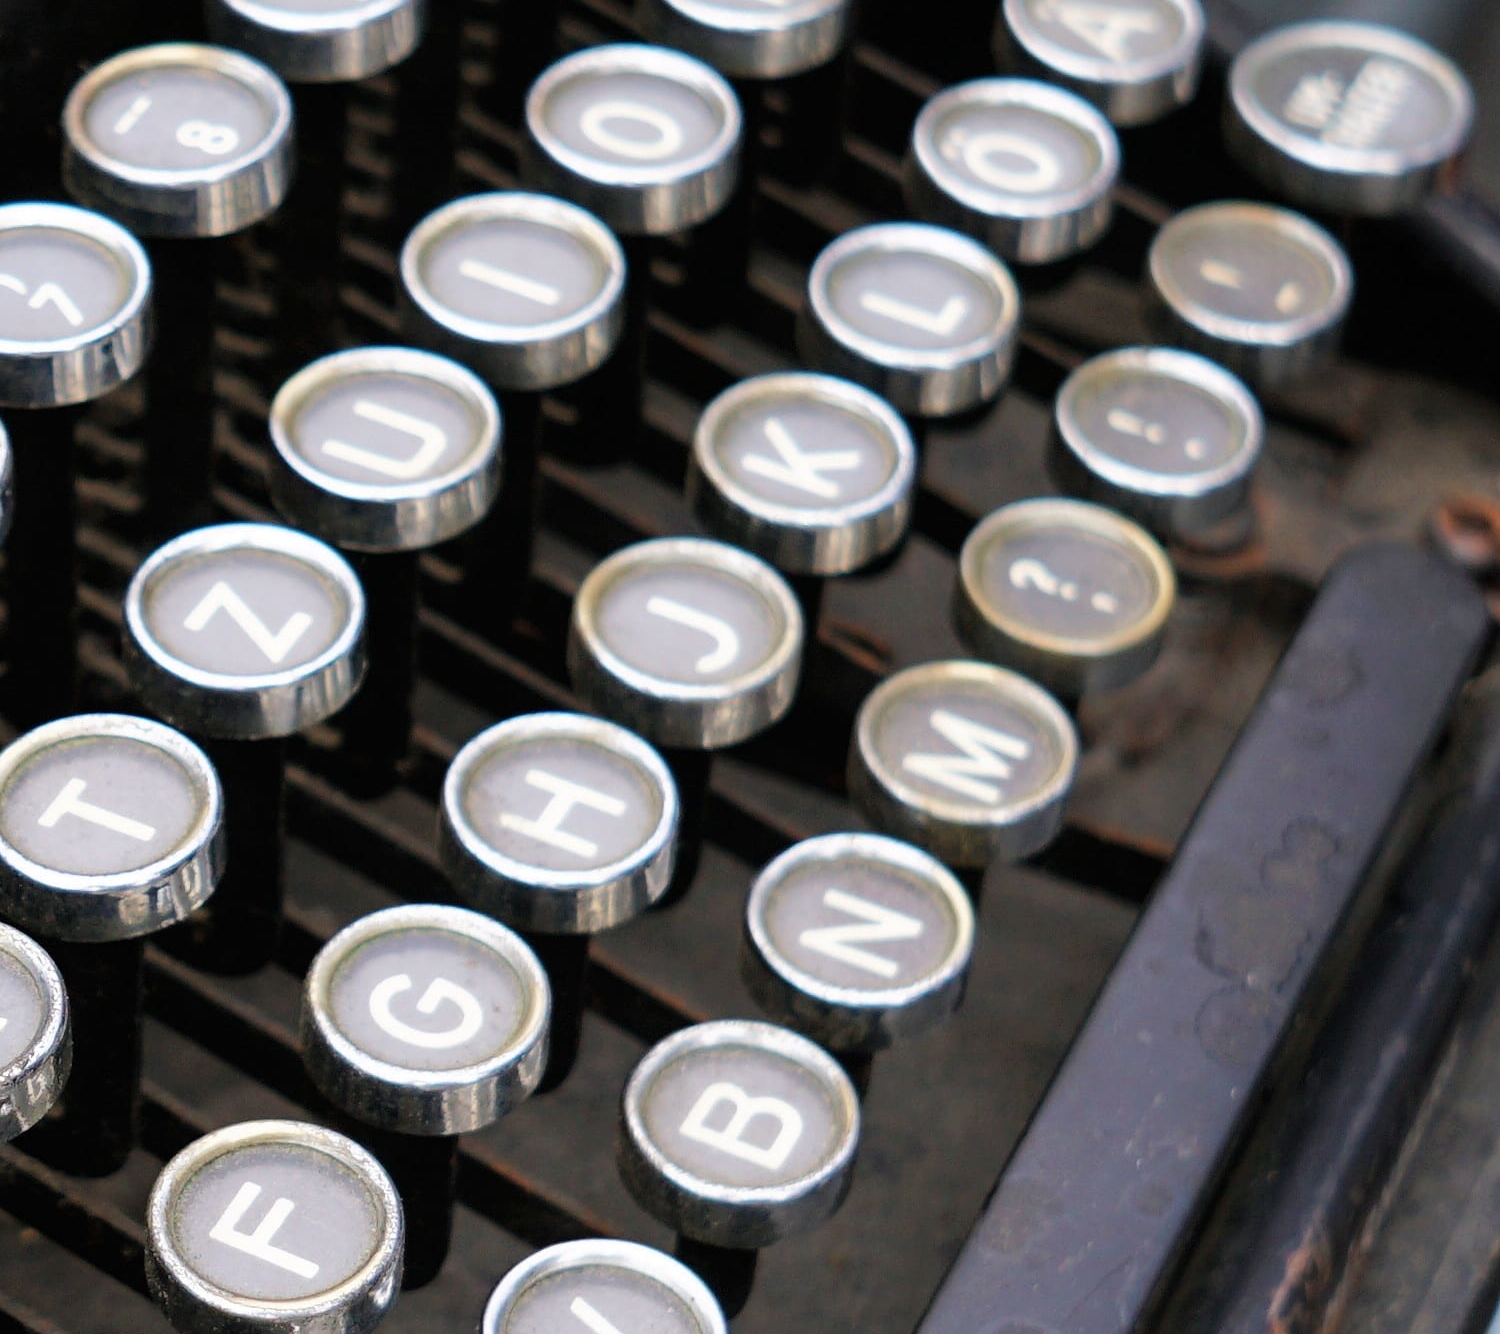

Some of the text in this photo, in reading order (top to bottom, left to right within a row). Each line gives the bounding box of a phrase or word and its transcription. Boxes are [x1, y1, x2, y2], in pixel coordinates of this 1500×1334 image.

[176, 121, 239, 154] 8
[580, 101, 683, 159] O
[938, 126, 1063, 195] Ö
[28, 283, 83, 326] 7
[862, 287, 972, 335] L
[322, 401, 447, 478] U
[739, 420, 862, 499] K
[1010, 560, 1082, 600] ?
[184, 582, 312, 663] Z
[647, 597, 739, 673] J
[902, 711, 1028, 805] M
[38, 778, 155, 841] T
[501, 770, 626, 858] H
[799, 890, 922, 978] N
[369, 974, 483, 1048] G
[680, 1082, 803, 1170] B
[209, 1182, 319, 1279] F
